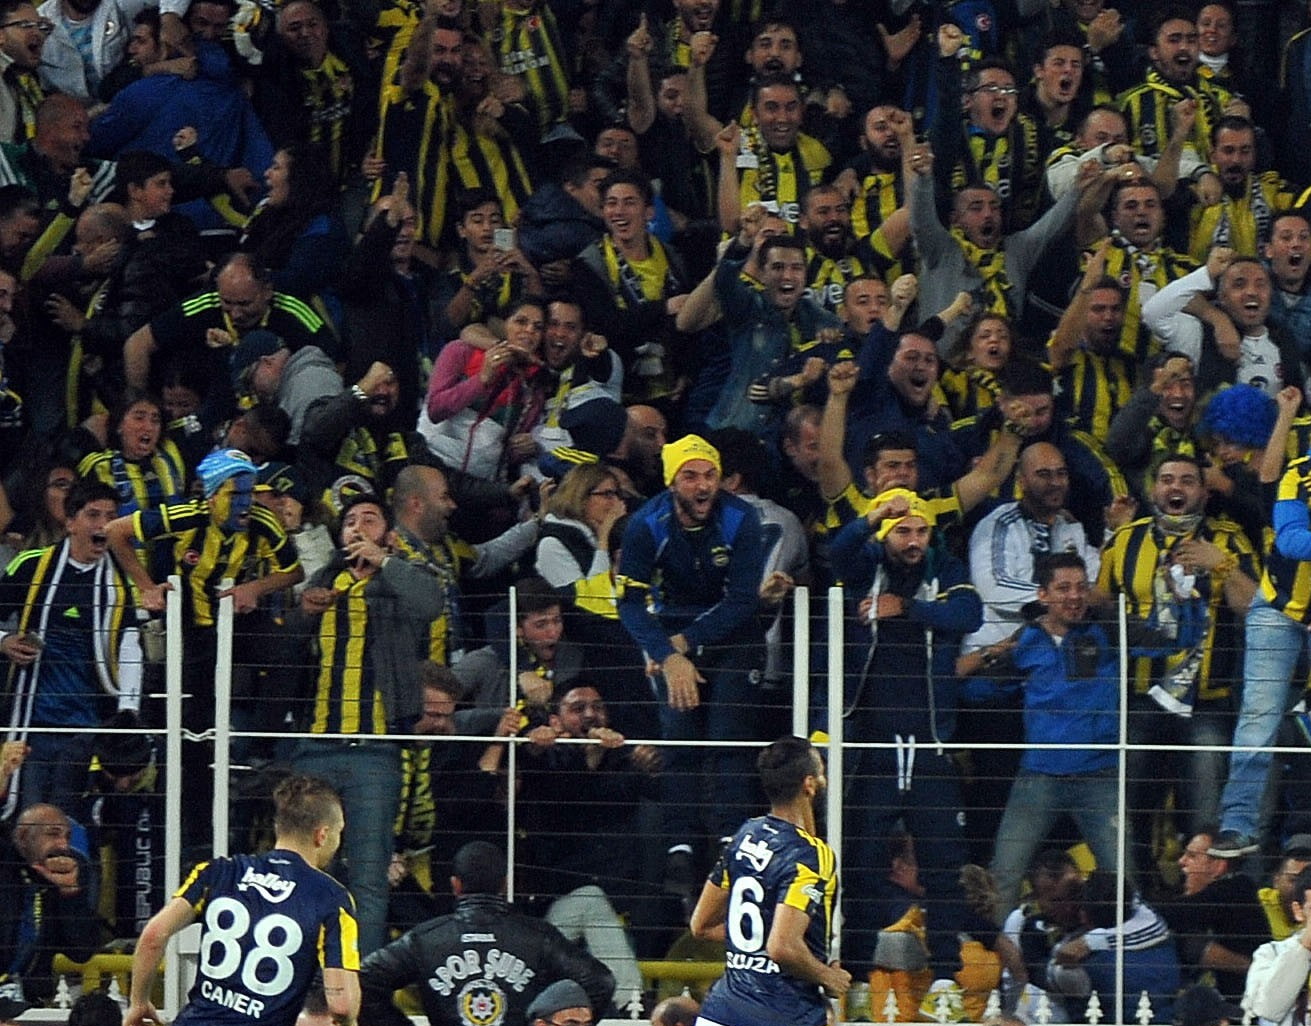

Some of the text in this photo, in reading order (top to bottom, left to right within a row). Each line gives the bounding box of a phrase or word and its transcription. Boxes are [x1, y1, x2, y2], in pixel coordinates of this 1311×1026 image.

[200, 896, 303, 997] 88
[728, 876, 765, 953] 6
[428, 949, 483, 996] SPOR
